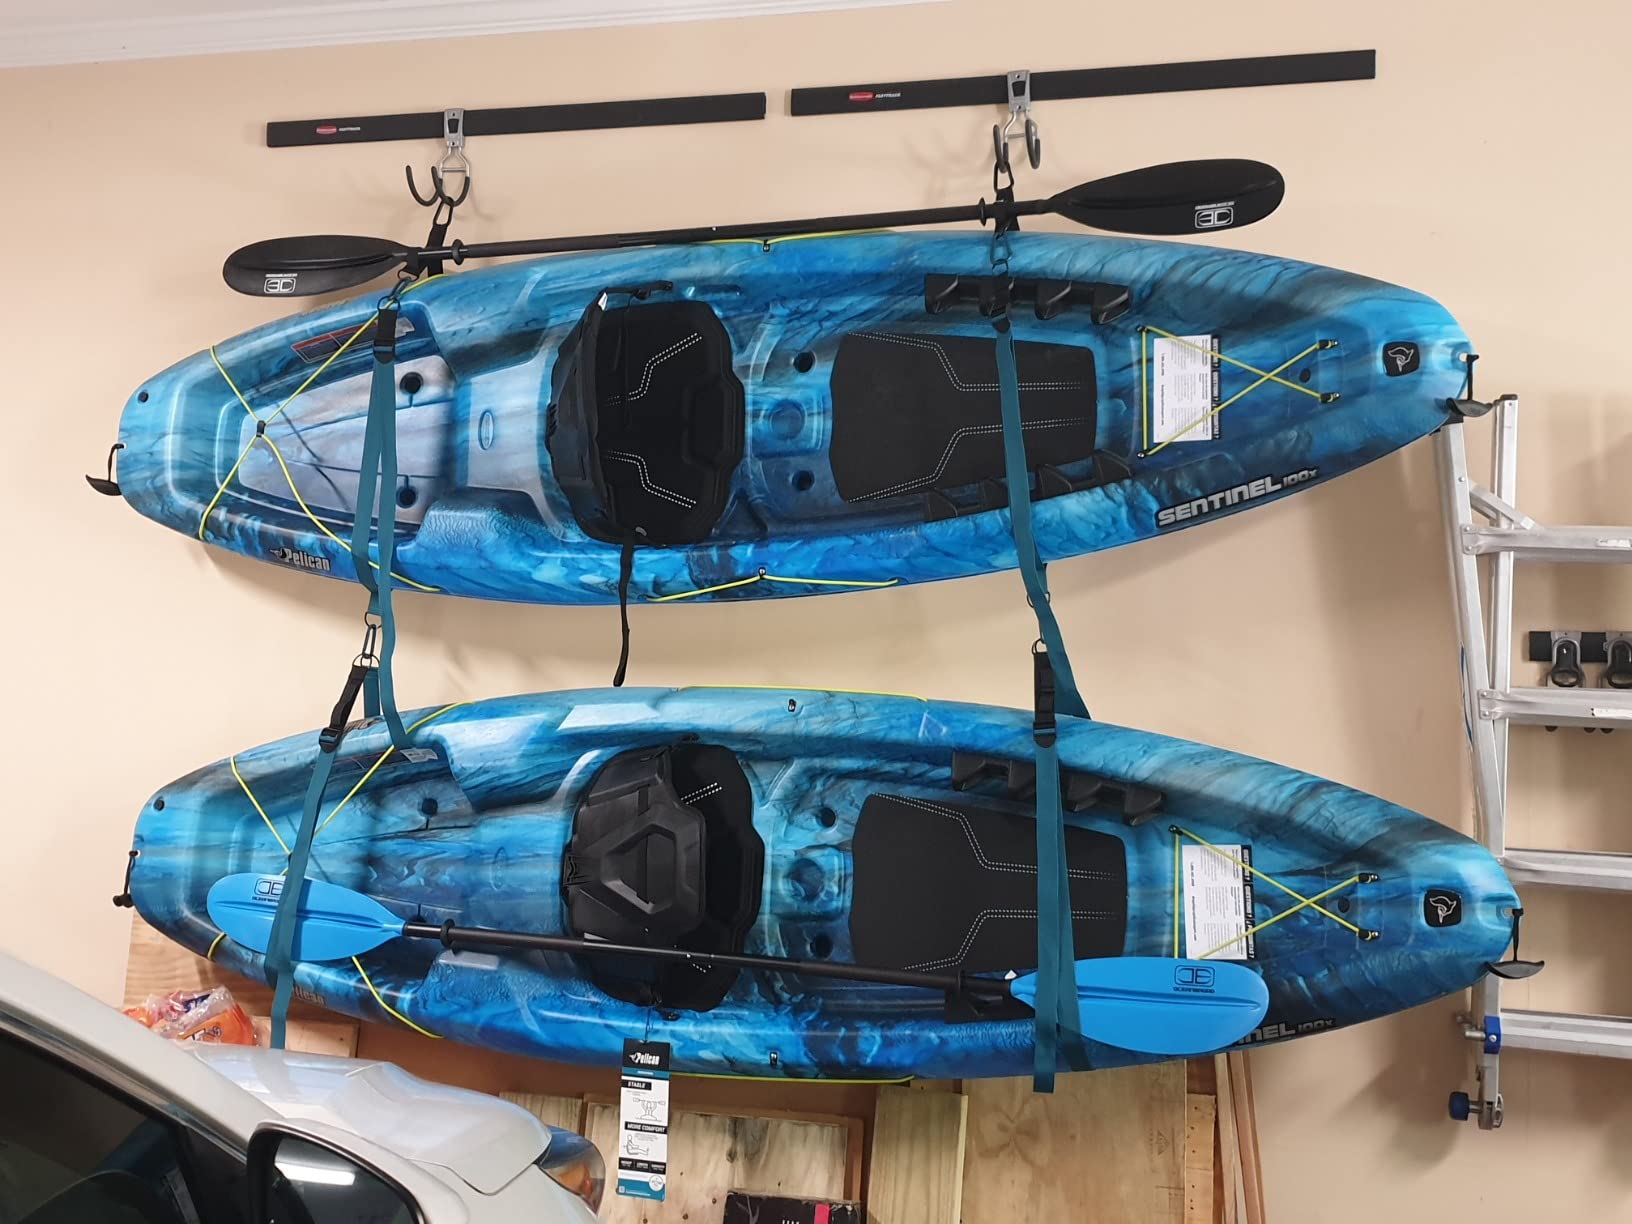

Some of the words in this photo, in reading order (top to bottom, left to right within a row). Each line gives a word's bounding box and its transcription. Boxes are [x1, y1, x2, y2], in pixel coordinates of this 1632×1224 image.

[1158, 476, 1282, 526] SENTINEL
[281, 548, 330, 571] Pelican
[632, 1052, 660, 1065] Pelican
